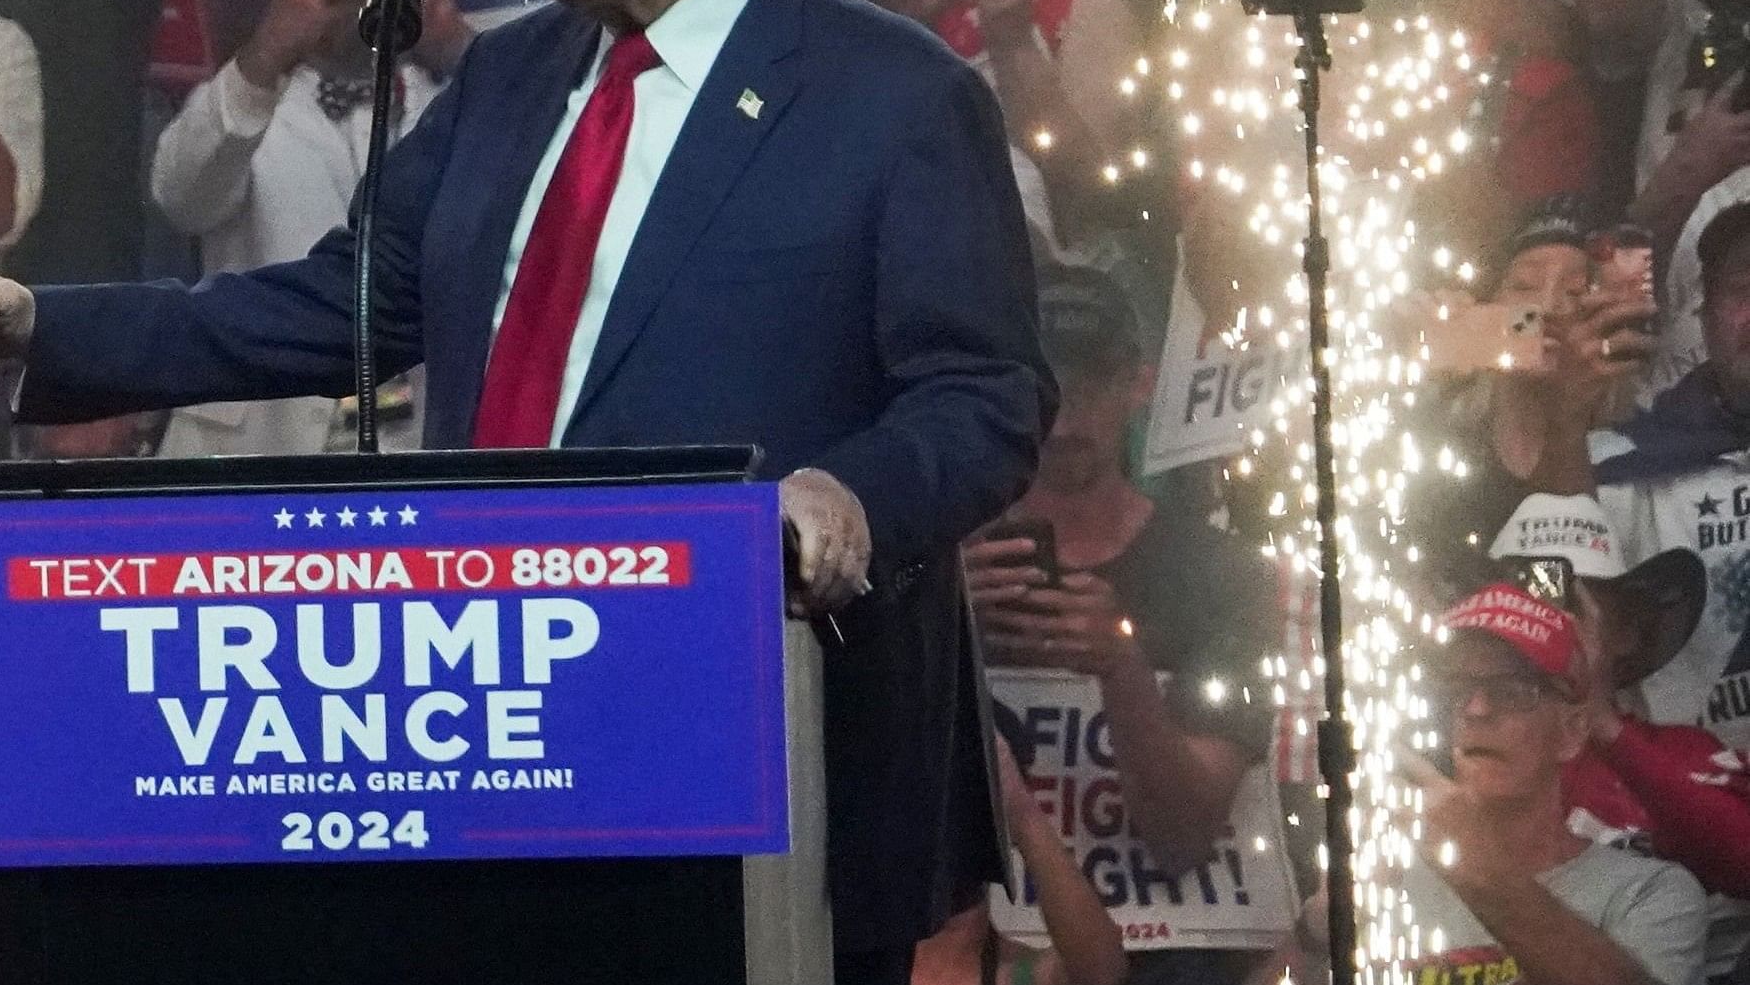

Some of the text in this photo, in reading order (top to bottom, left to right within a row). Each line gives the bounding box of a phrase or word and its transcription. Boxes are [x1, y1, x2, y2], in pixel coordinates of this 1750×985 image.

[30, 545, 670, 598] TEXT ARIZONA TO 88022
[100, 597, 600, 693] TRUMP
[157, 690, 545, 766] VANCE
[135, 768, 573, 796] MAKE AMERICA GREAT AGAIN!
[281, 809, 430, 851] 2024
[1124, 921, 1171, 940] 024
